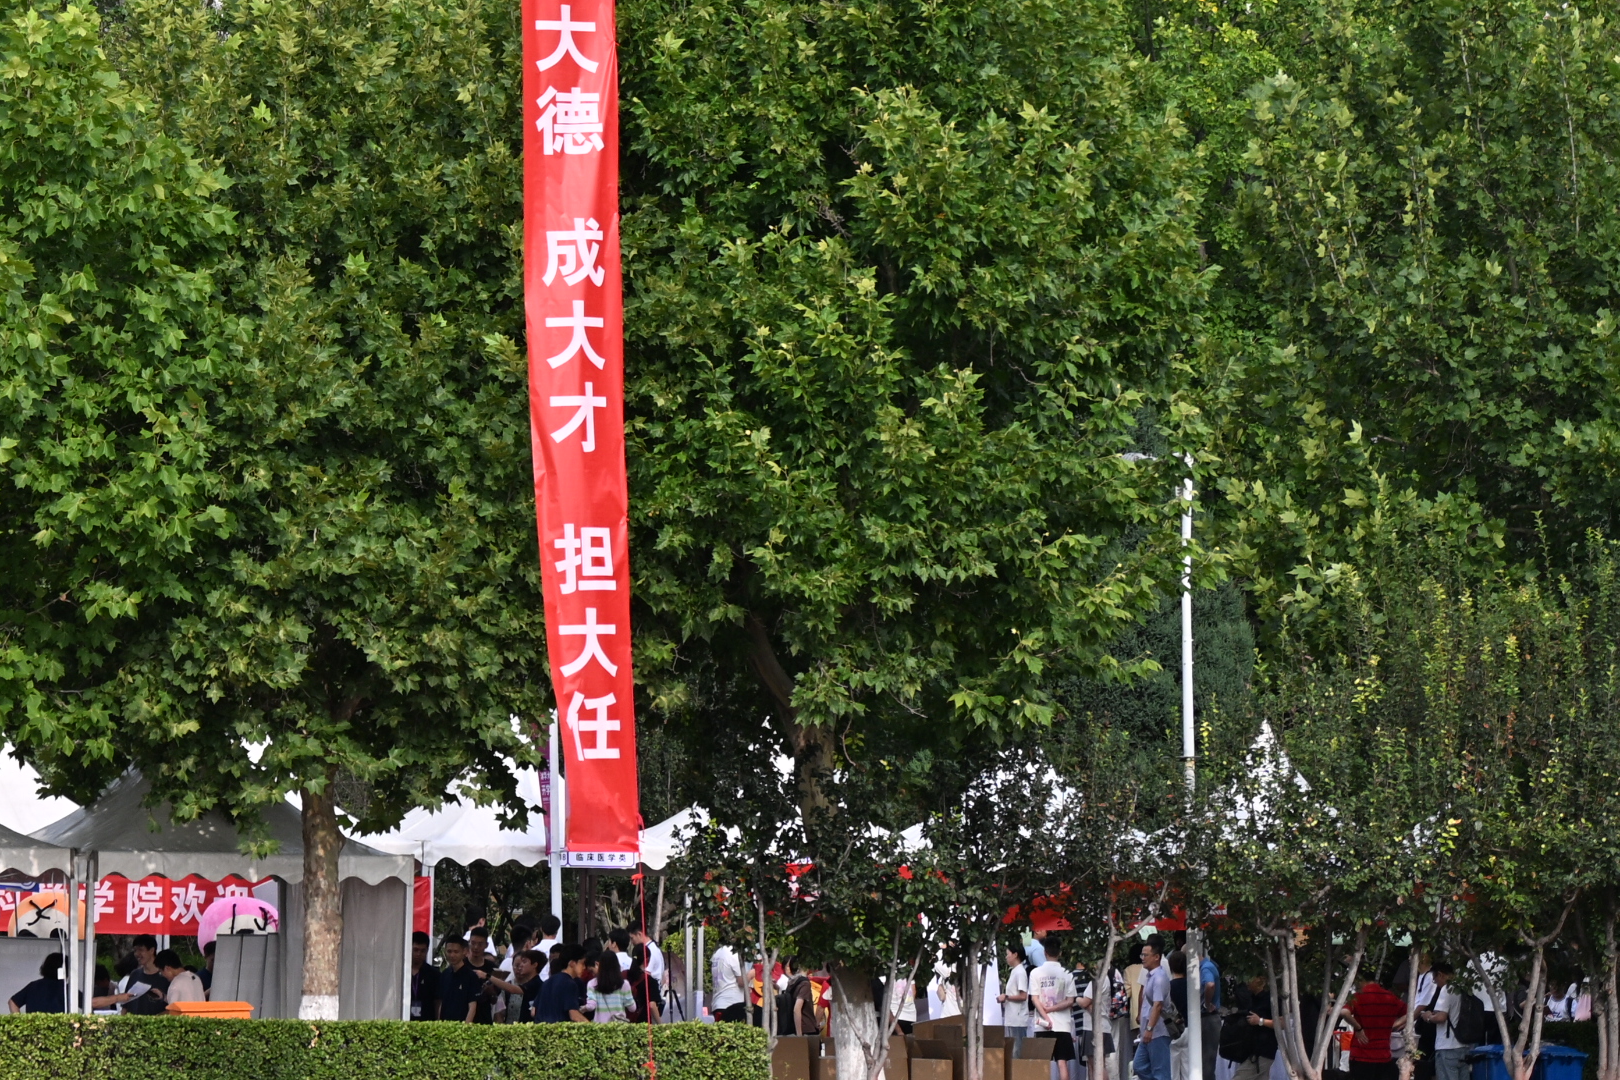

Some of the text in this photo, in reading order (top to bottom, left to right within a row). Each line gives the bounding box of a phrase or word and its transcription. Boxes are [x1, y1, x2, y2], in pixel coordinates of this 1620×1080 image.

[542, 218, 606, 452] 成大才
[554, 524, 620, 762] 担大任
[576, 853, 627, 862] 临床医学类
